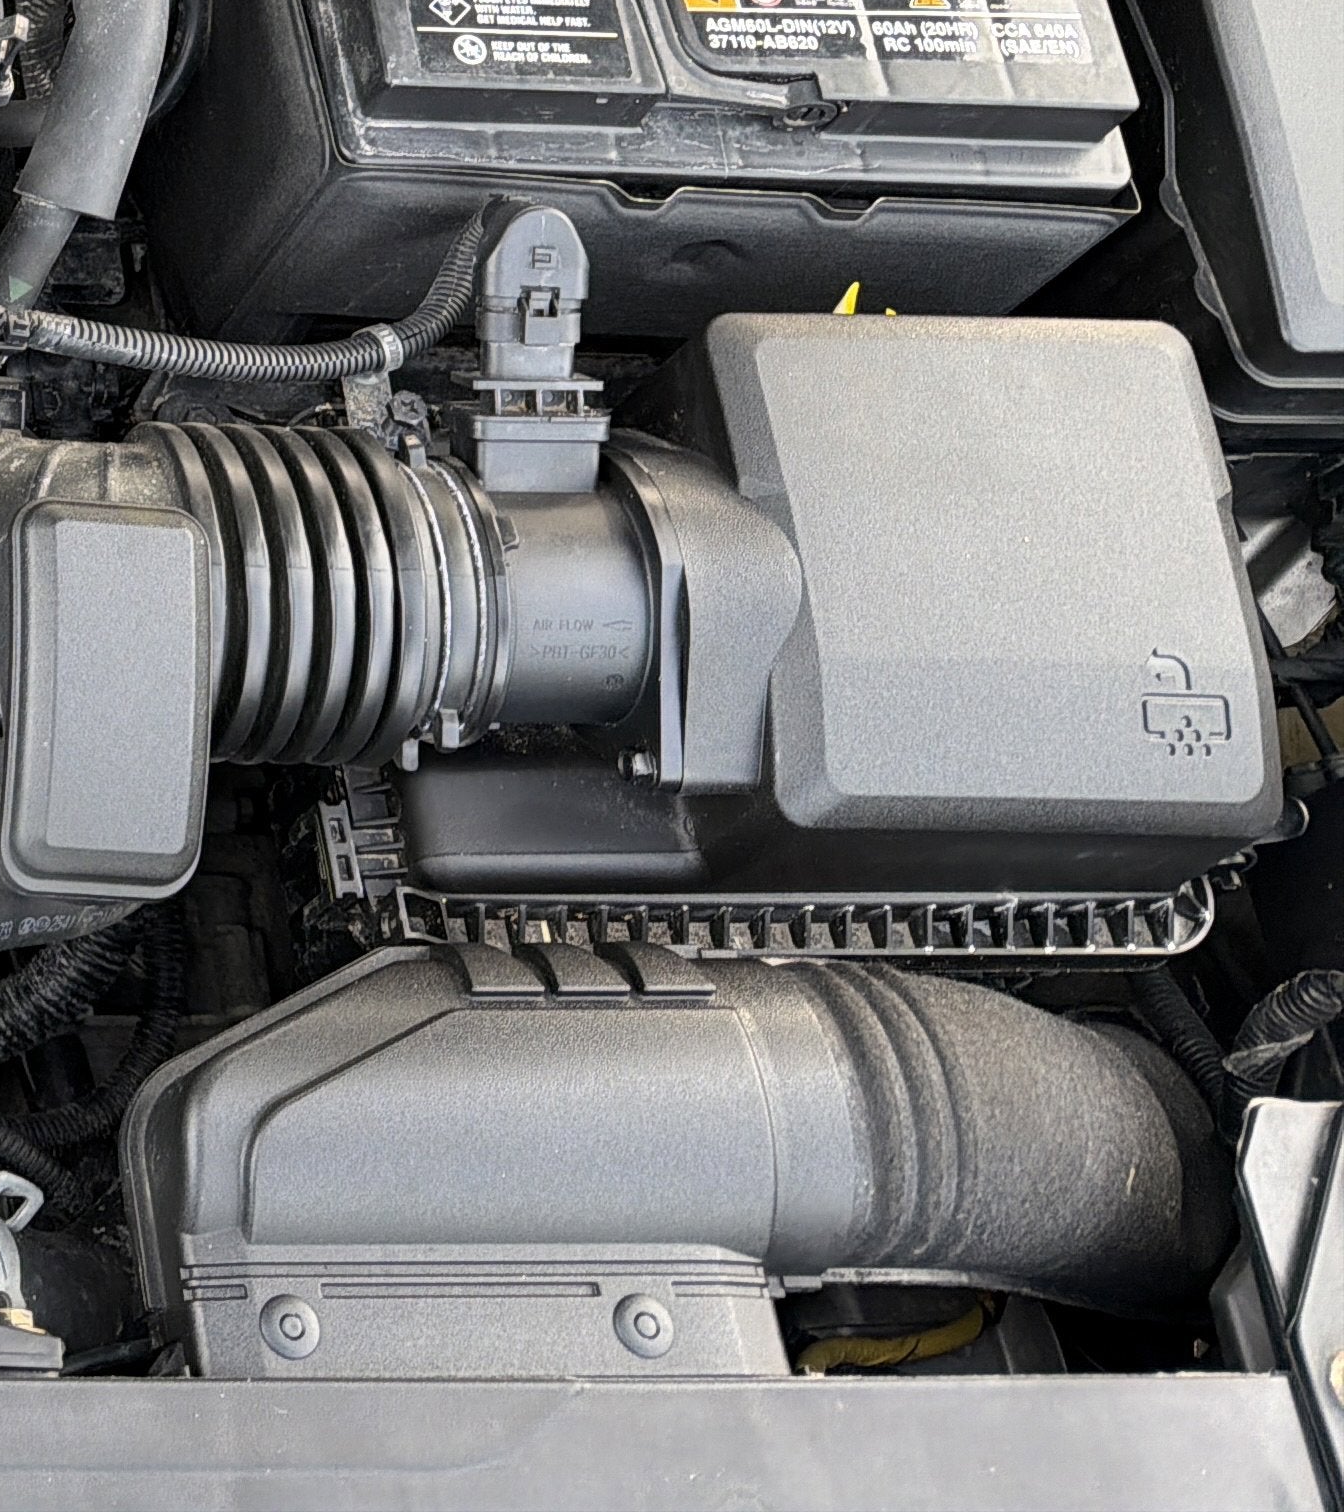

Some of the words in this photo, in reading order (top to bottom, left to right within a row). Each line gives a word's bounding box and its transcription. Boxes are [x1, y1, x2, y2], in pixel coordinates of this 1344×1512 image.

[706, 18, 855, 37] AGM60L-DIN(12V)
[872, 22, 916, 36] 60Ah
[920, 21, 978, 39] (20HR)
[990, 22, 1030, 38] CCA
[708, 35, 818, 50] 37110-AB620
[884, 37, 911, 52] RC
[914, 37, 977, 53] 100min
[534, 618, 553, 631] AIR
[558, 618, 594, 632] FLOW
